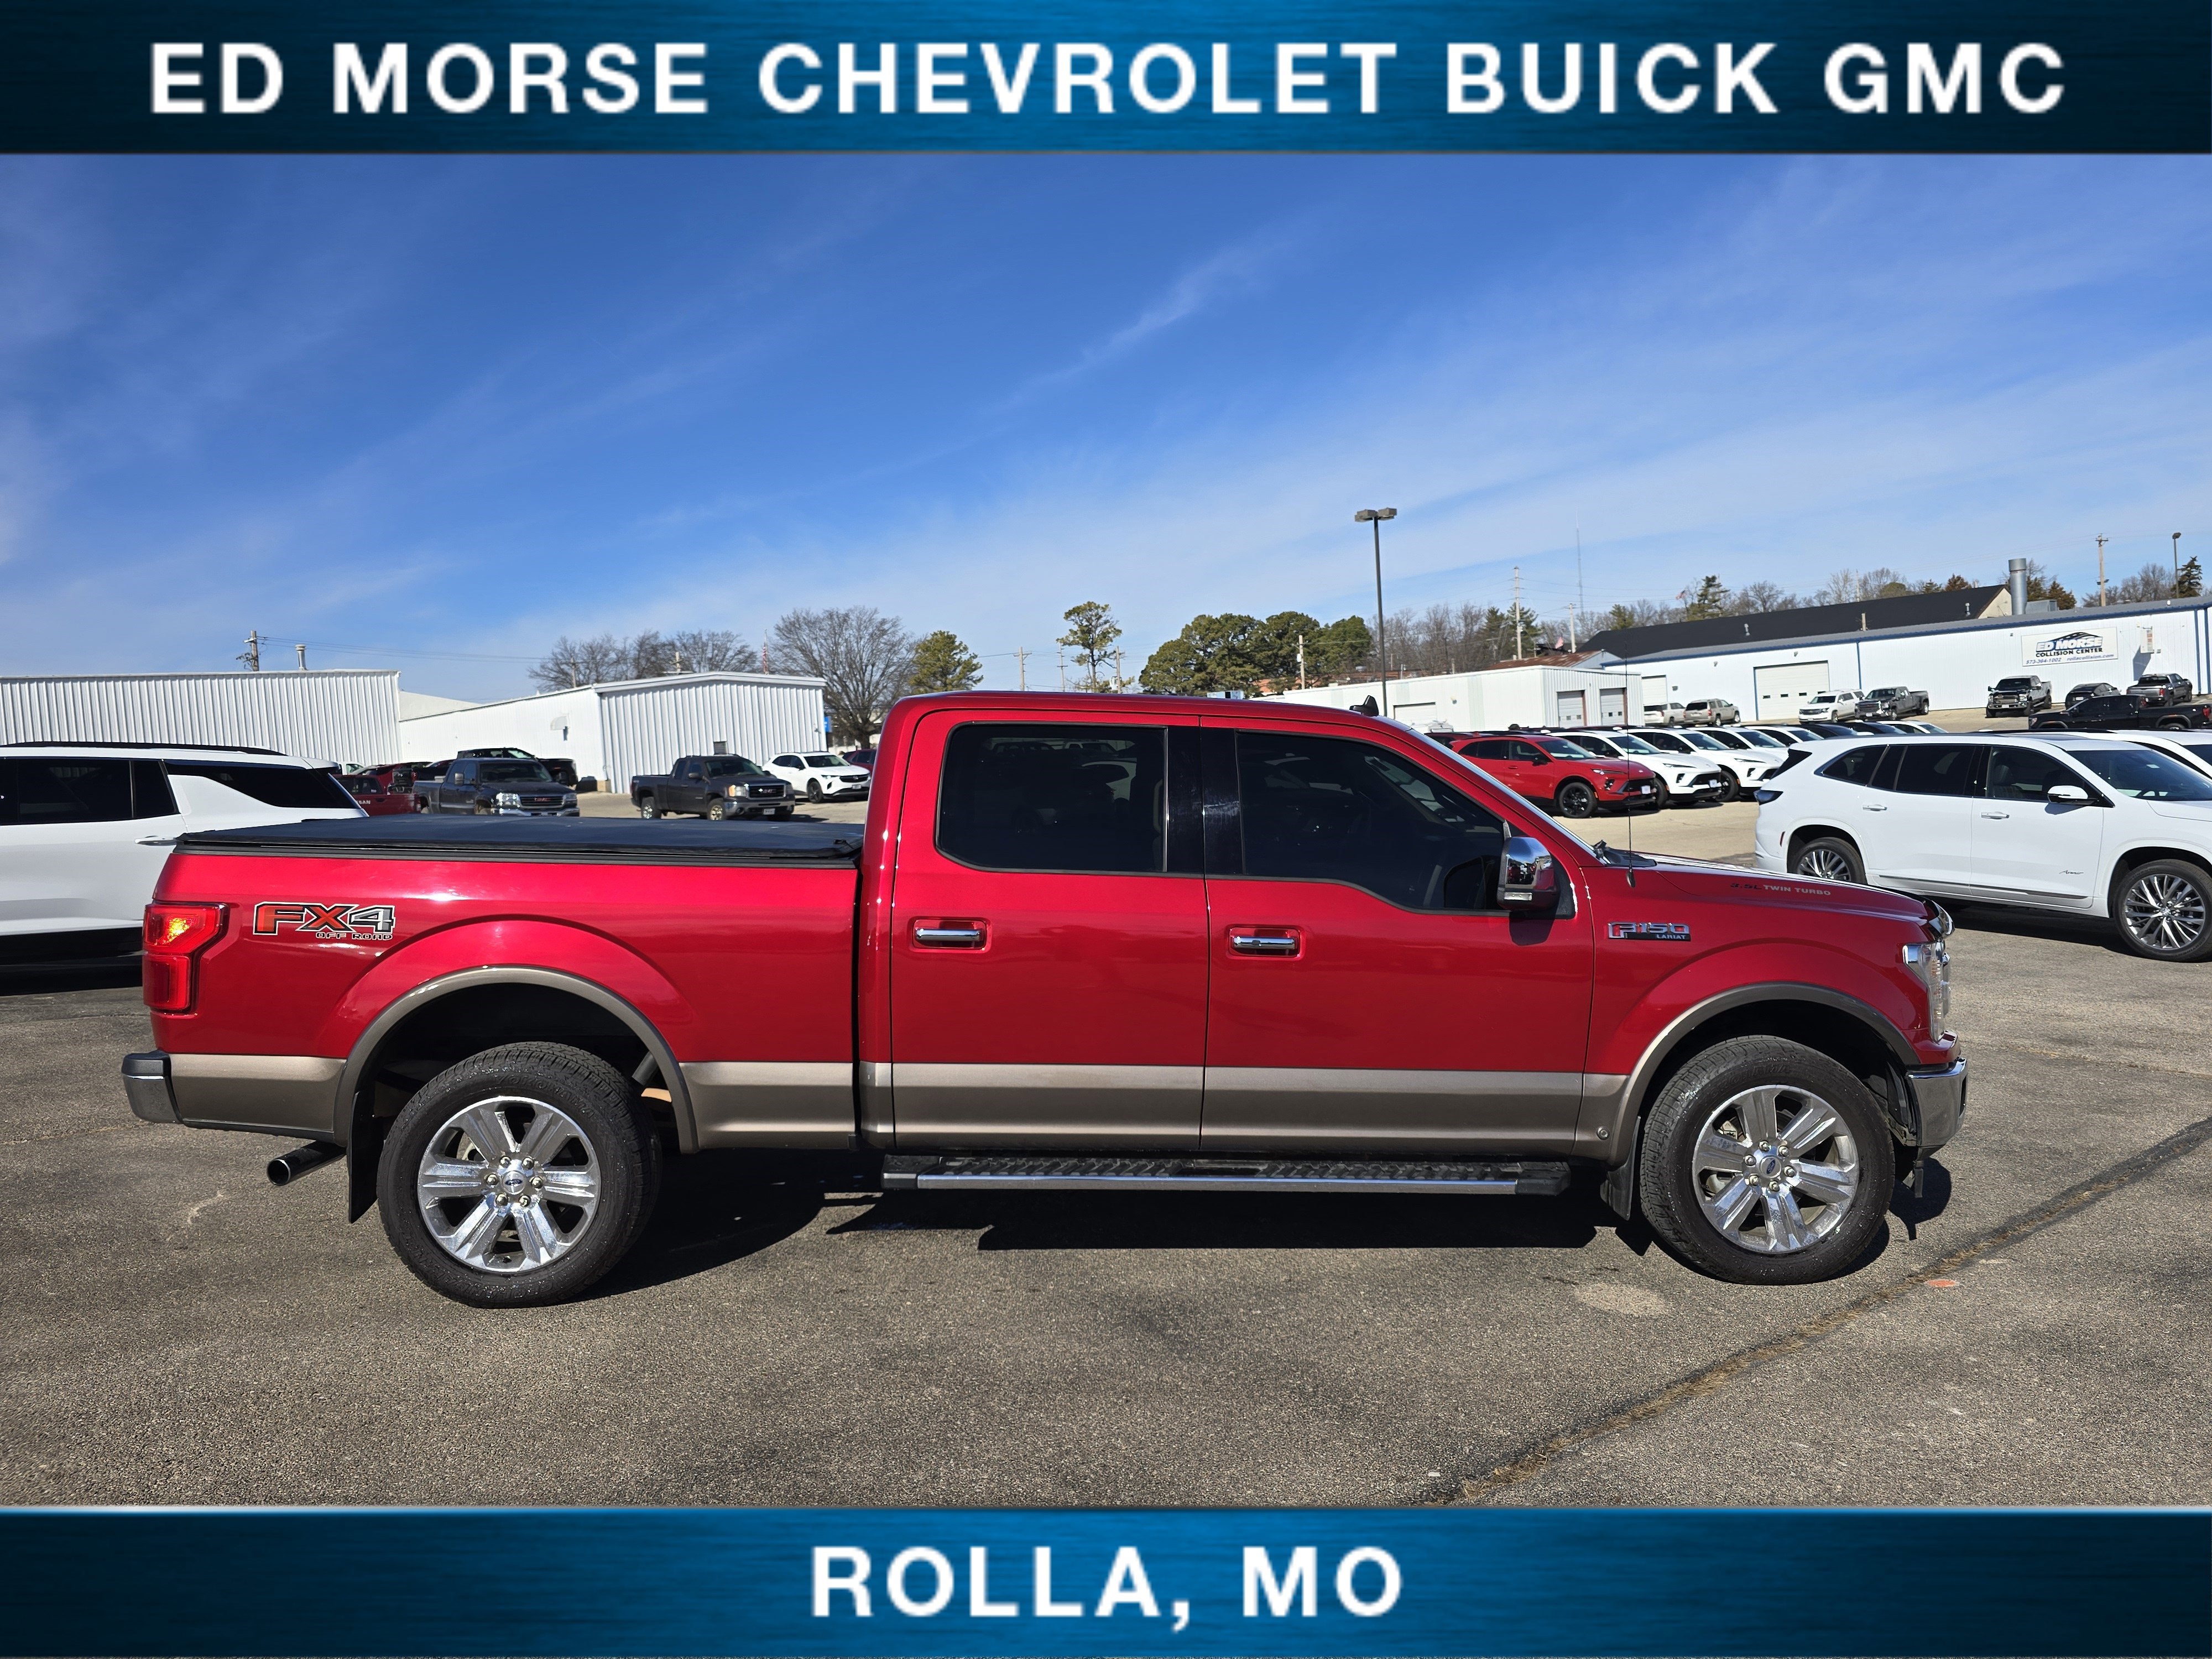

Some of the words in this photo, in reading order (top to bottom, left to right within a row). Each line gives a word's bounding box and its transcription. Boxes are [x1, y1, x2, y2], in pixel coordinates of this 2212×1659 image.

[2036, 641, 2054, 652] ED
[2055, 636, 2103, 650] MORSE
[1794, 887, 1832, 895] TURBO
[253, 901, 396, 936] FX4
[351, 932, 393, 941] ROAD
